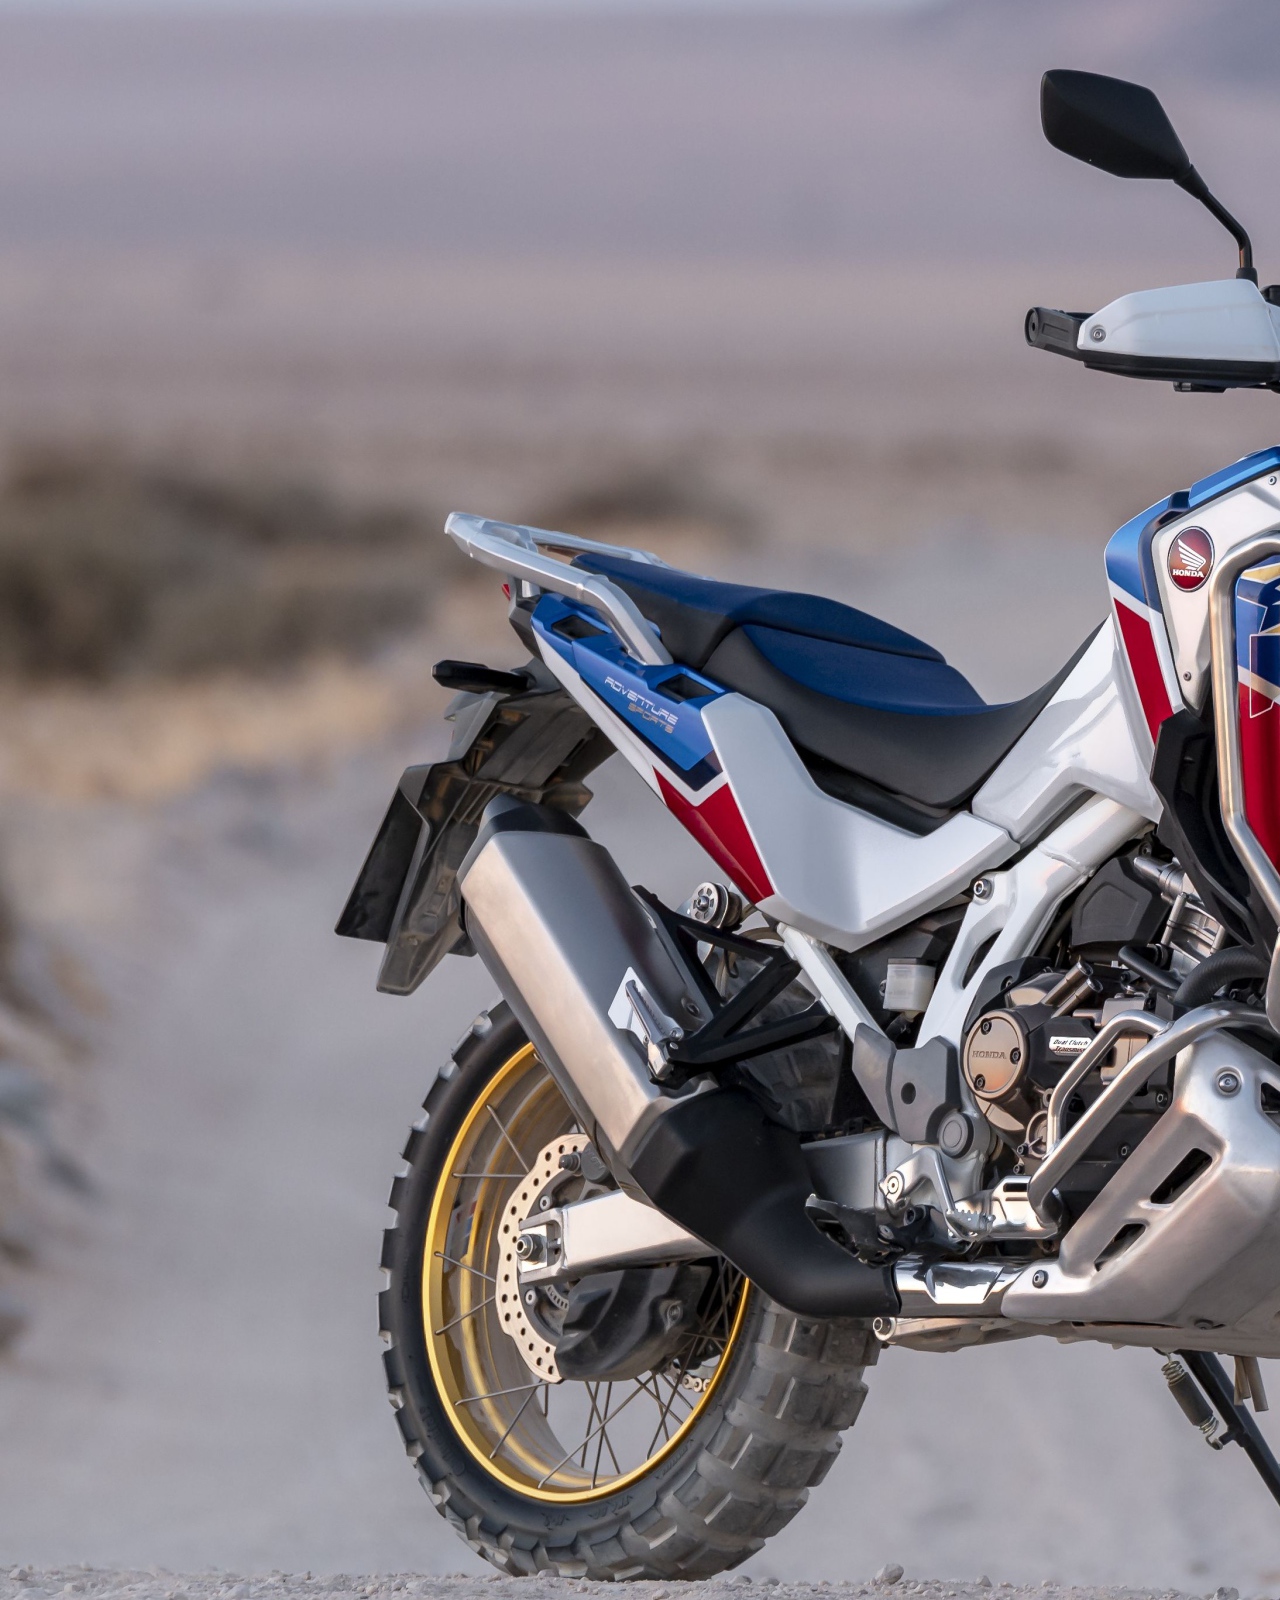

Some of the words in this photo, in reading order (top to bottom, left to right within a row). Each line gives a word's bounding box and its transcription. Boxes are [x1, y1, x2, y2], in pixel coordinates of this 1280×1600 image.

[1172, 568, 1205, 578] HONDA
[604, 676, 679, 726] ADVENTURE
[628, 703, 674, 734] SPORTS
[971, 1050, 1007, 1060] HONDA
